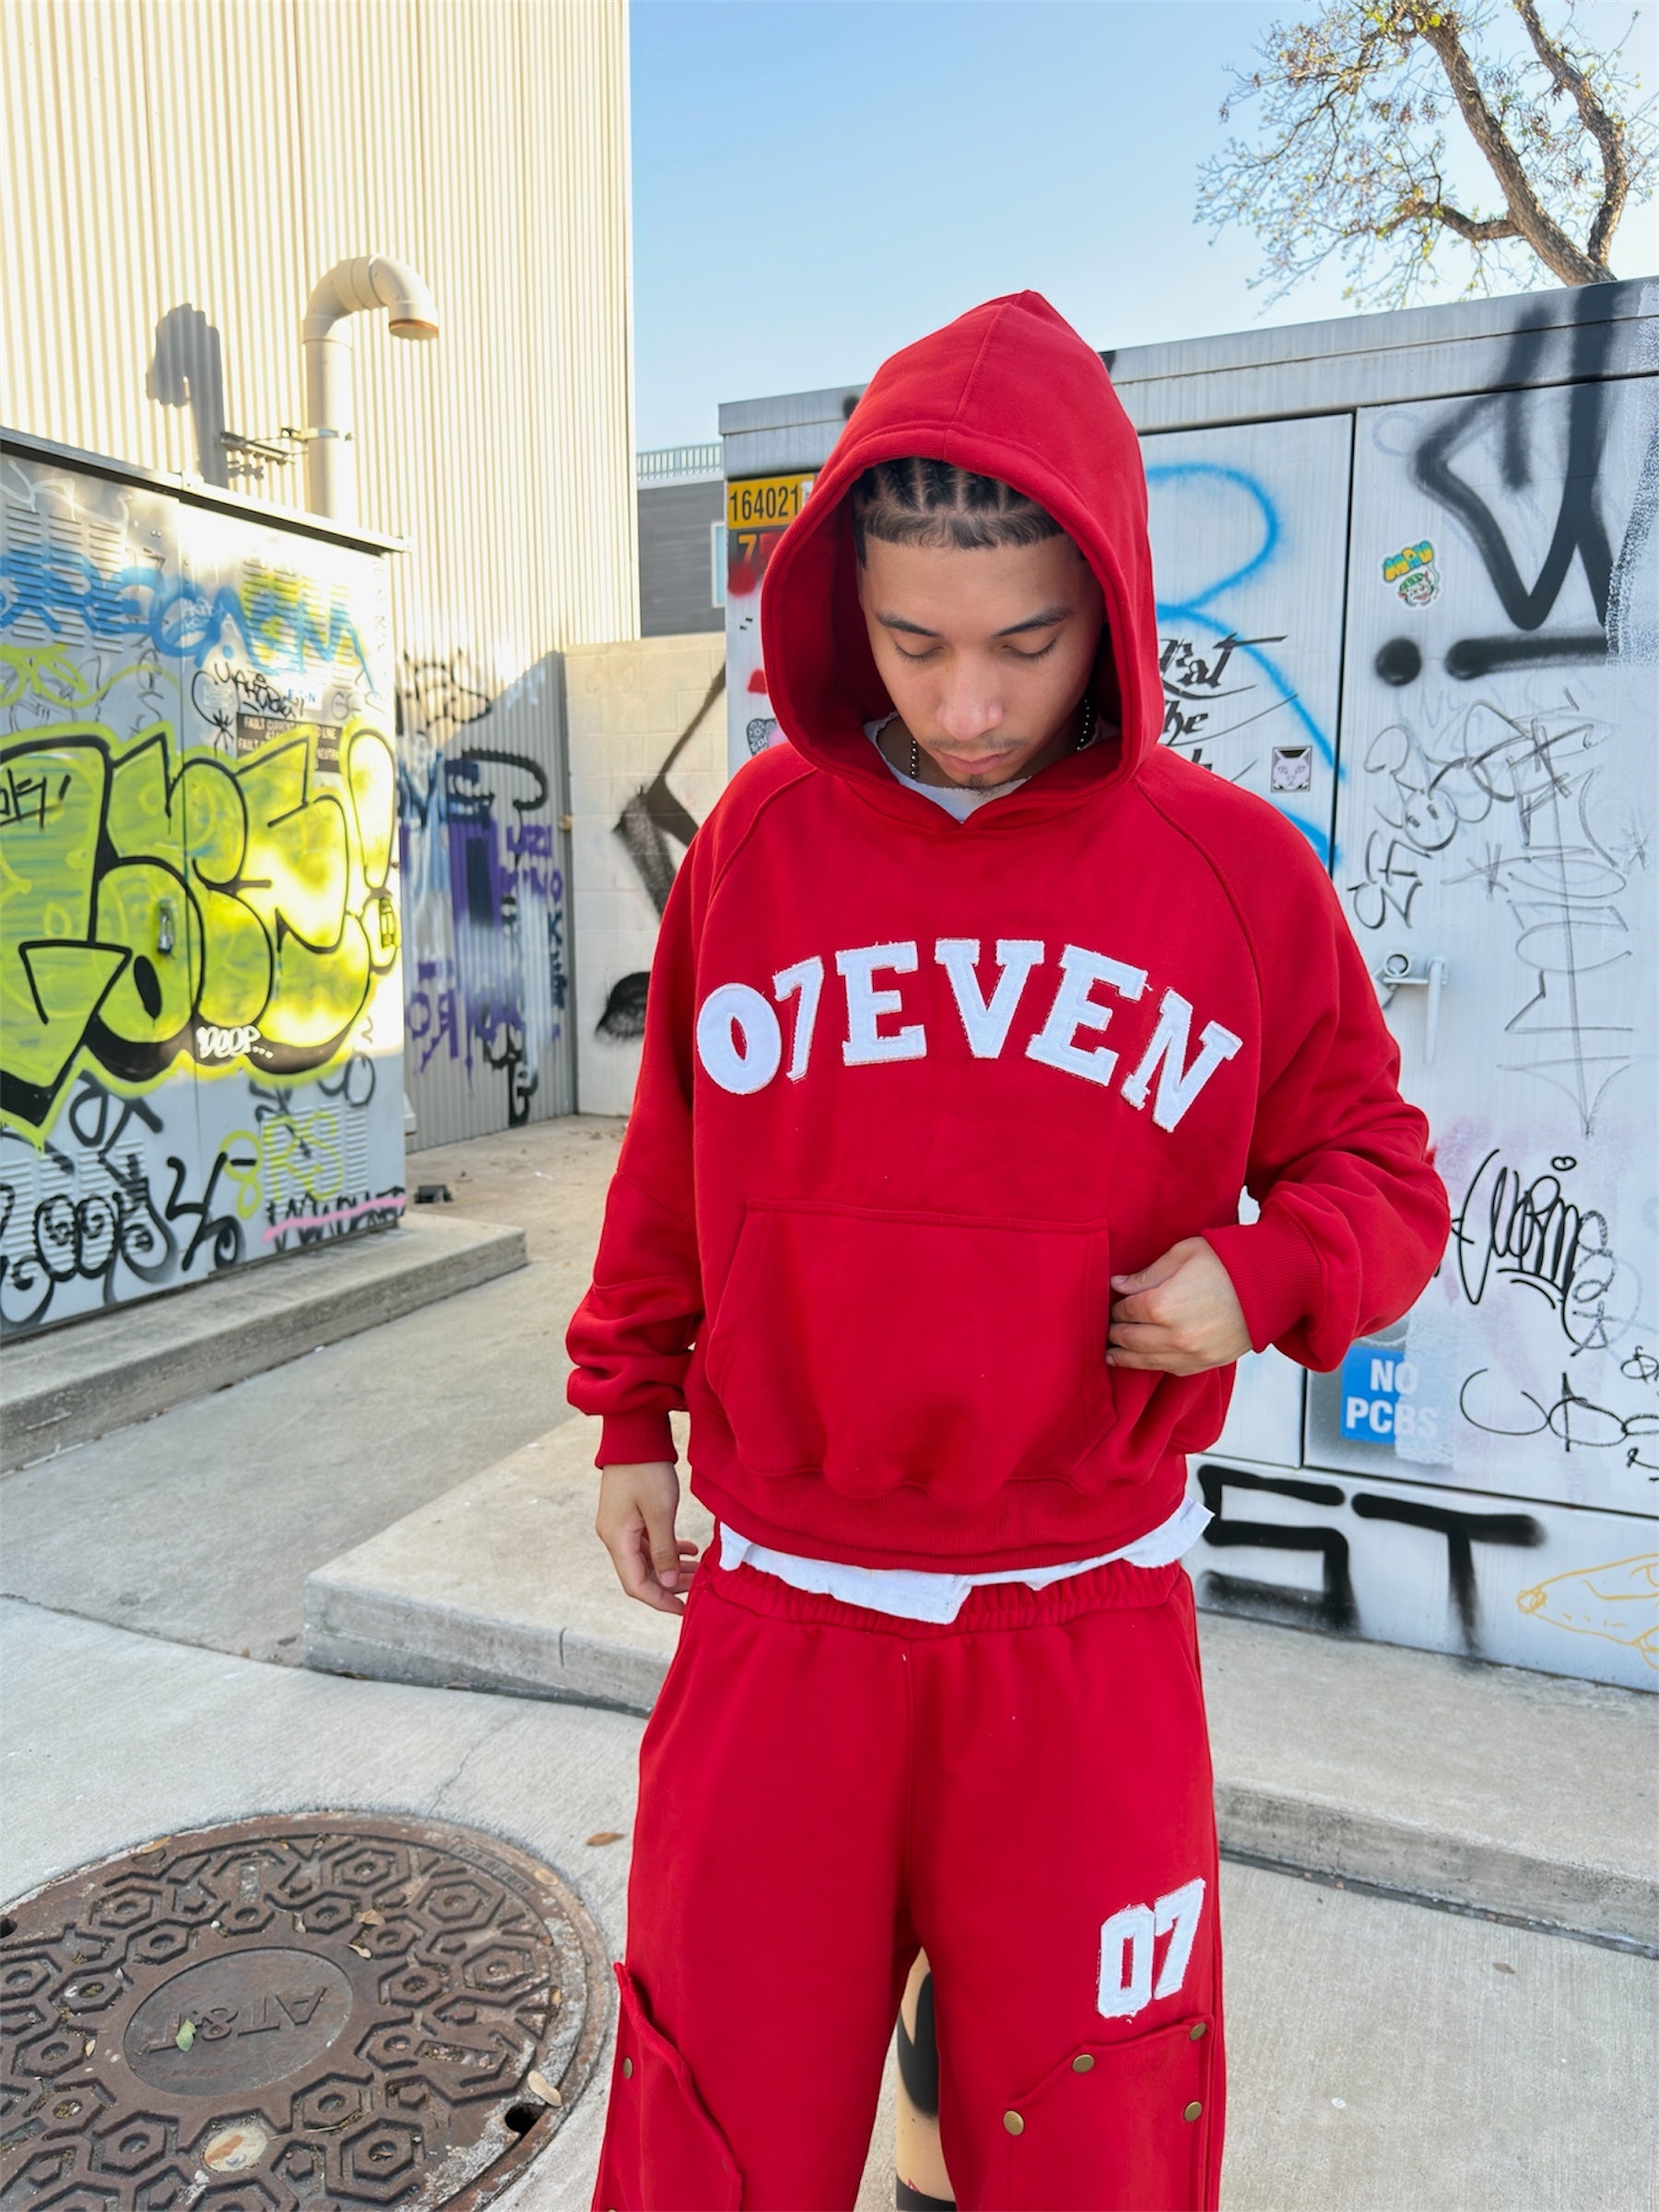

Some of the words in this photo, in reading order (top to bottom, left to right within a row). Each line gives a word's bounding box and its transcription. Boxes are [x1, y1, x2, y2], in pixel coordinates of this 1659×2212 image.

[729, 484, 799, 522] 164021
[1370, 1358, 1419, 1396] NO
[1346, 1395, 1440, 1438] PCBS
[1096, 1877, 1206, 2019] 07
[147, 1985, 329, 2055] AT&T
